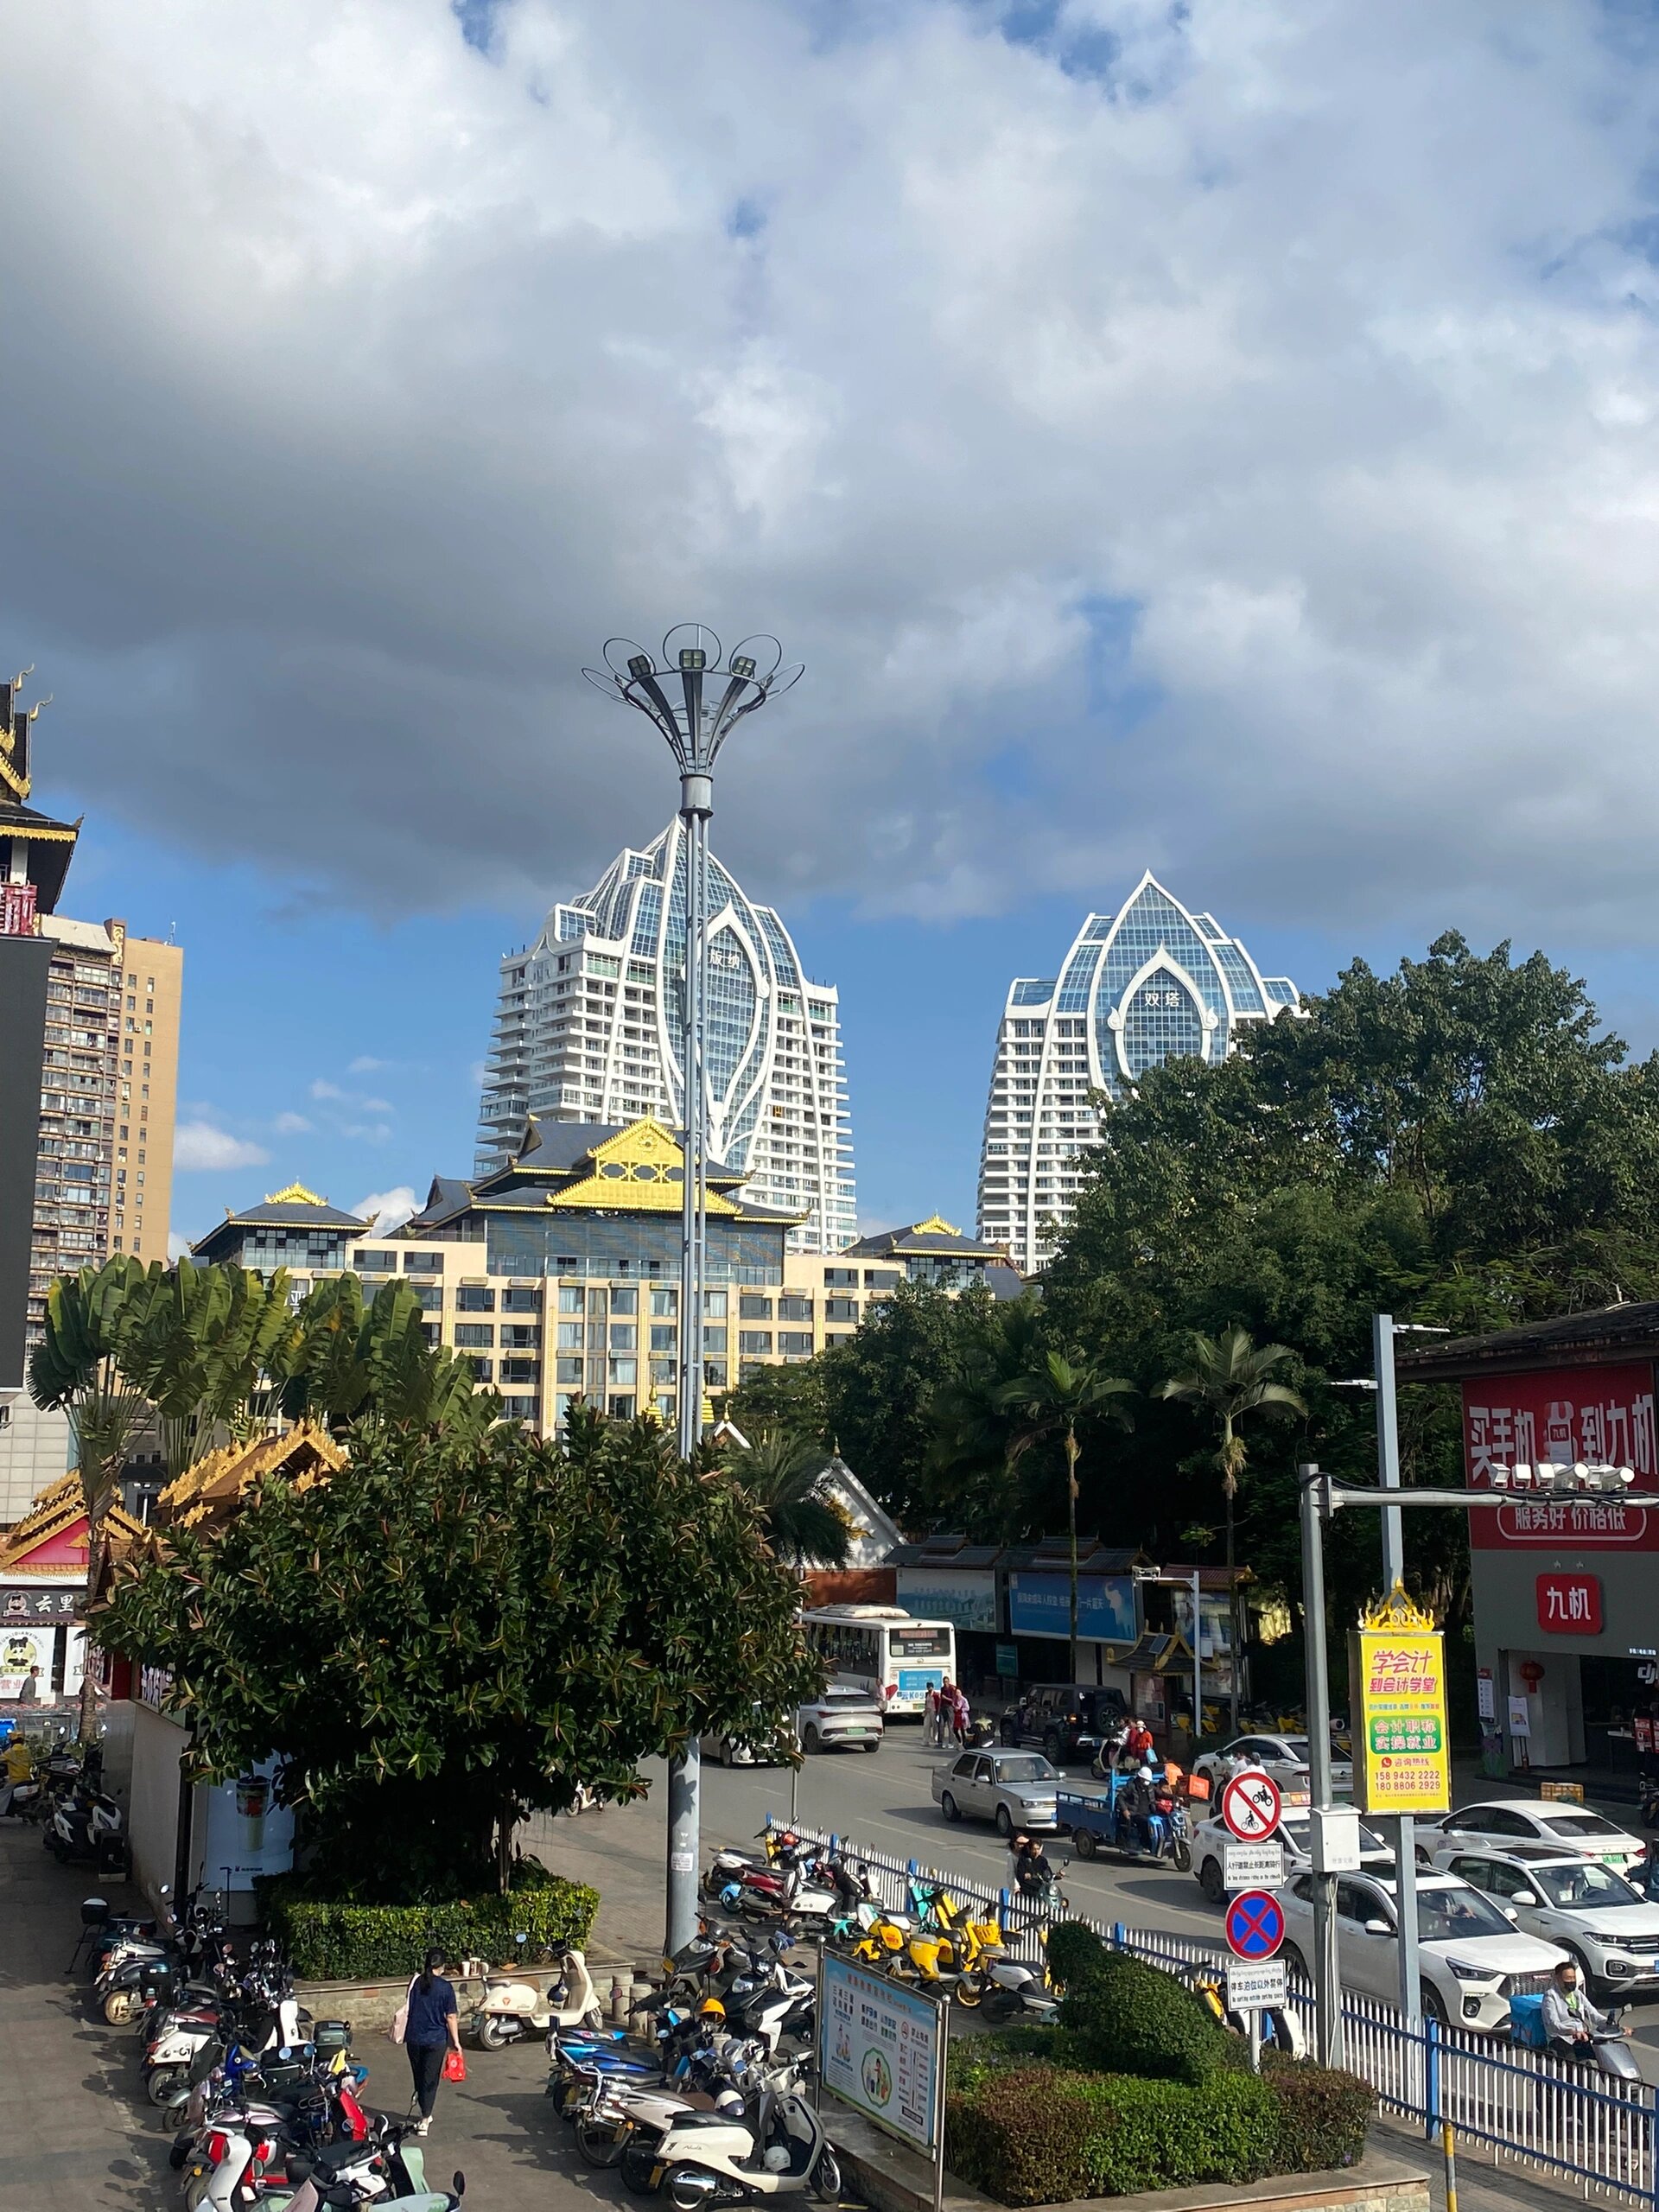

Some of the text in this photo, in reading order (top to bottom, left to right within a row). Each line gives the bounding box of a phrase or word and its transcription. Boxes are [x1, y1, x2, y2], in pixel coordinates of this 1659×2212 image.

[1144, 992, 1180, 1007] 双塔
[1469, 1405, 1541, 1487] 买手机
[1515, 1507, 1626, 1530] 服务好 价格低
[35, 1594, 74, 1613] 云里
[1547, 1586, 1592, 1621] 九机
[1371, 1650, 1433, 1675] 学会计
[1370, 1677, 1436, 1693] 到会计学堂
[1375, 1719, 1436, 1734] 会计职称
[1375, 1735, 1437, 1751] 实操就业
[1376, 1770, 1440, 1780] 158 9432 2222
[1376, 1781, 1440, 1790] 180 8806 2929
[1231, 1978, 1283, 1992] 停车泊位以外禁停
